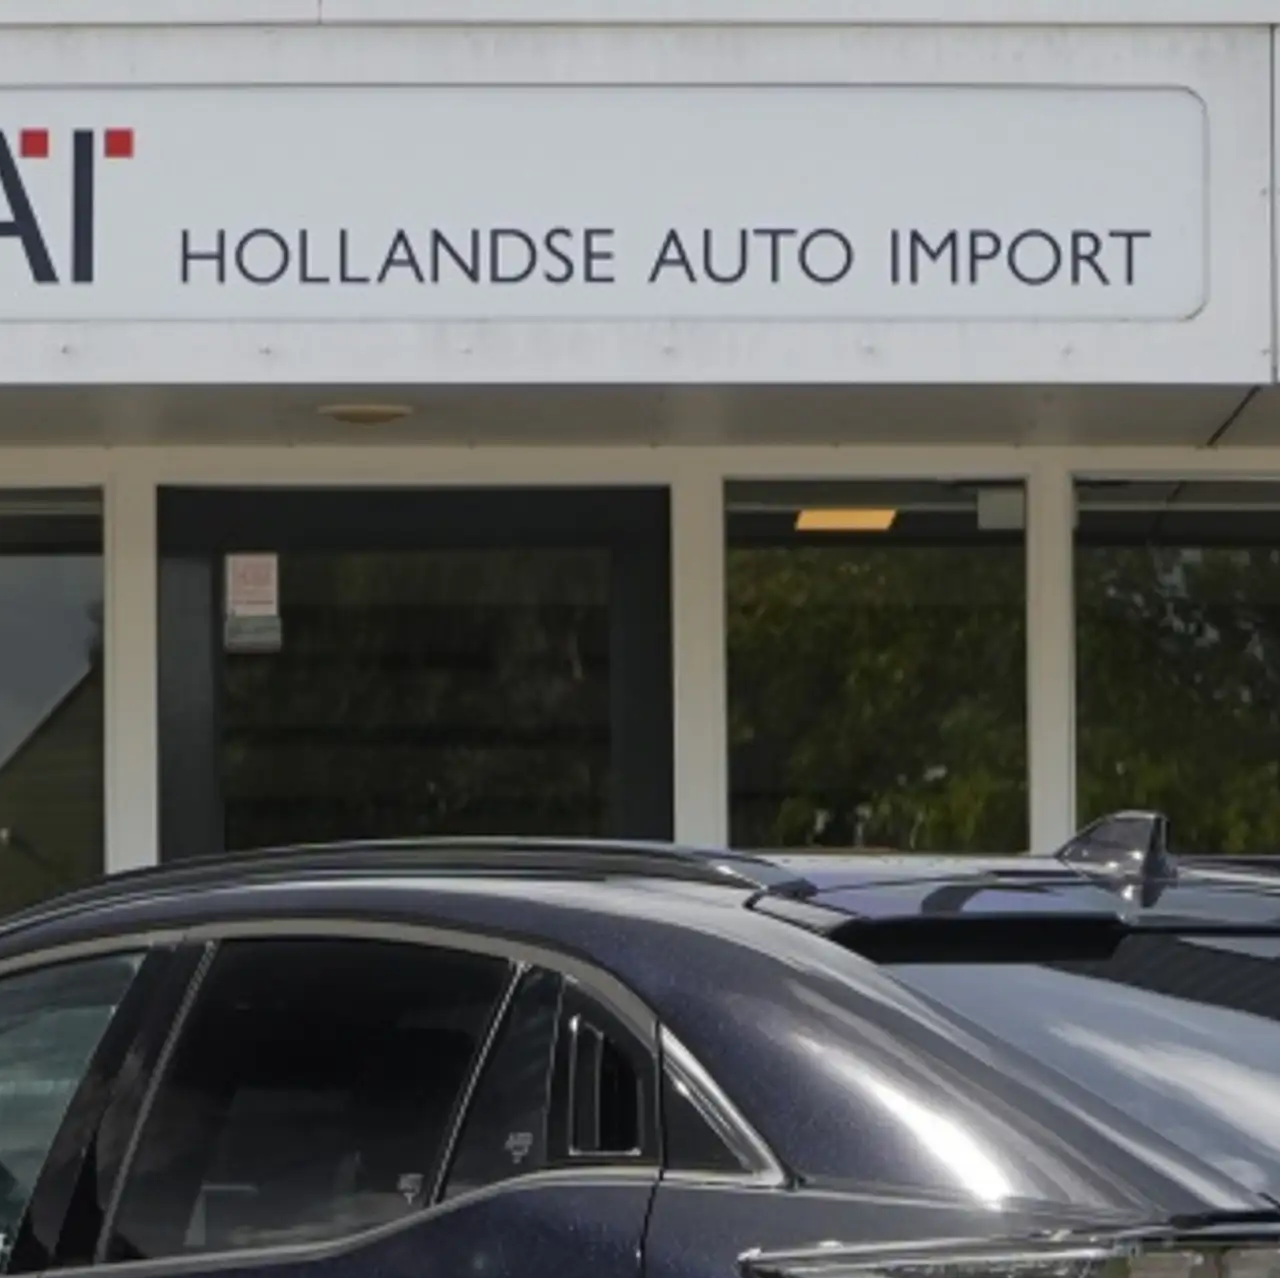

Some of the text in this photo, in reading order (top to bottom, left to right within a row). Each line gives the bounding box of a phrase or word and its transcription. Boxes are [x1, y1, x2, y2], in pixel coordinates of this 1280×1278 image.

[182, 228, 1151, 285] HOLLANDSE AUTO IMPORT
